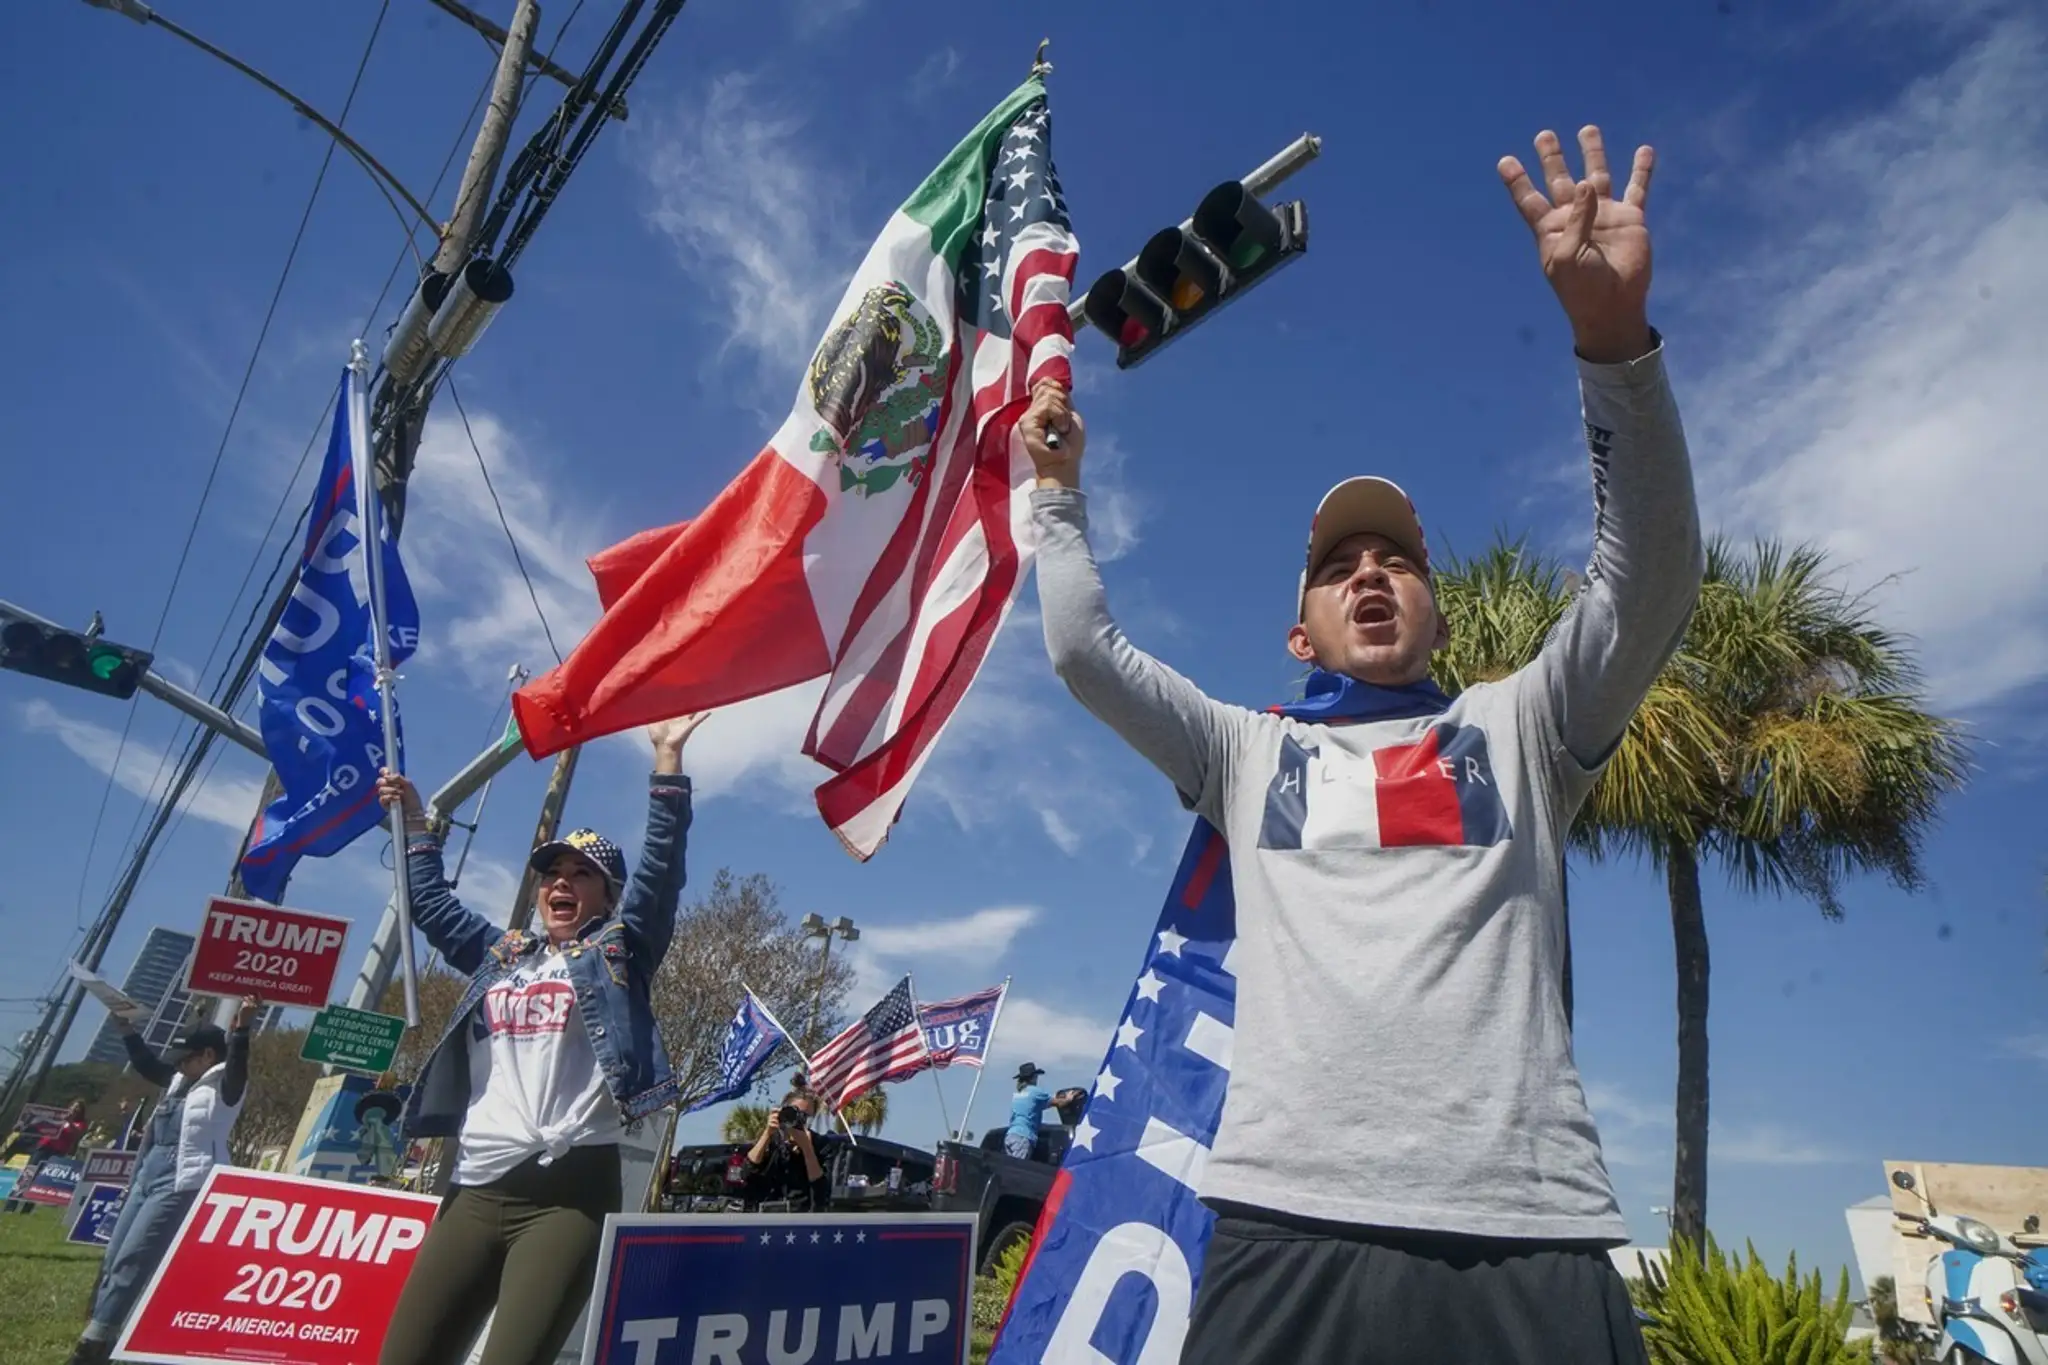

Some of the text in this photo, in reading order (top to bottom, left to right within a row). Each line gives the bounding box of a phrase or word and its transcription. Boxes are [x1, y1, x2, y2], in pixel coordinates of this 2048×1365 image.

[209, 911, 342, 955] TRUMP
[233, 950, 298, 977] 2020
[208, 972, 313, 994] KEEP AMERICA GREAT!
[327, 1015, 391, 1037] METROPOLITAN
[42, 1167, 69, 1179] KEN
[199, 1193, 426, 1264] TRUMP
[224, 1263, 342, 1311] 2020
[171, 1311, 360, 1345] KEEP AMERICA GREAT!
[621, 1299, 950, 1365] TRUMP
